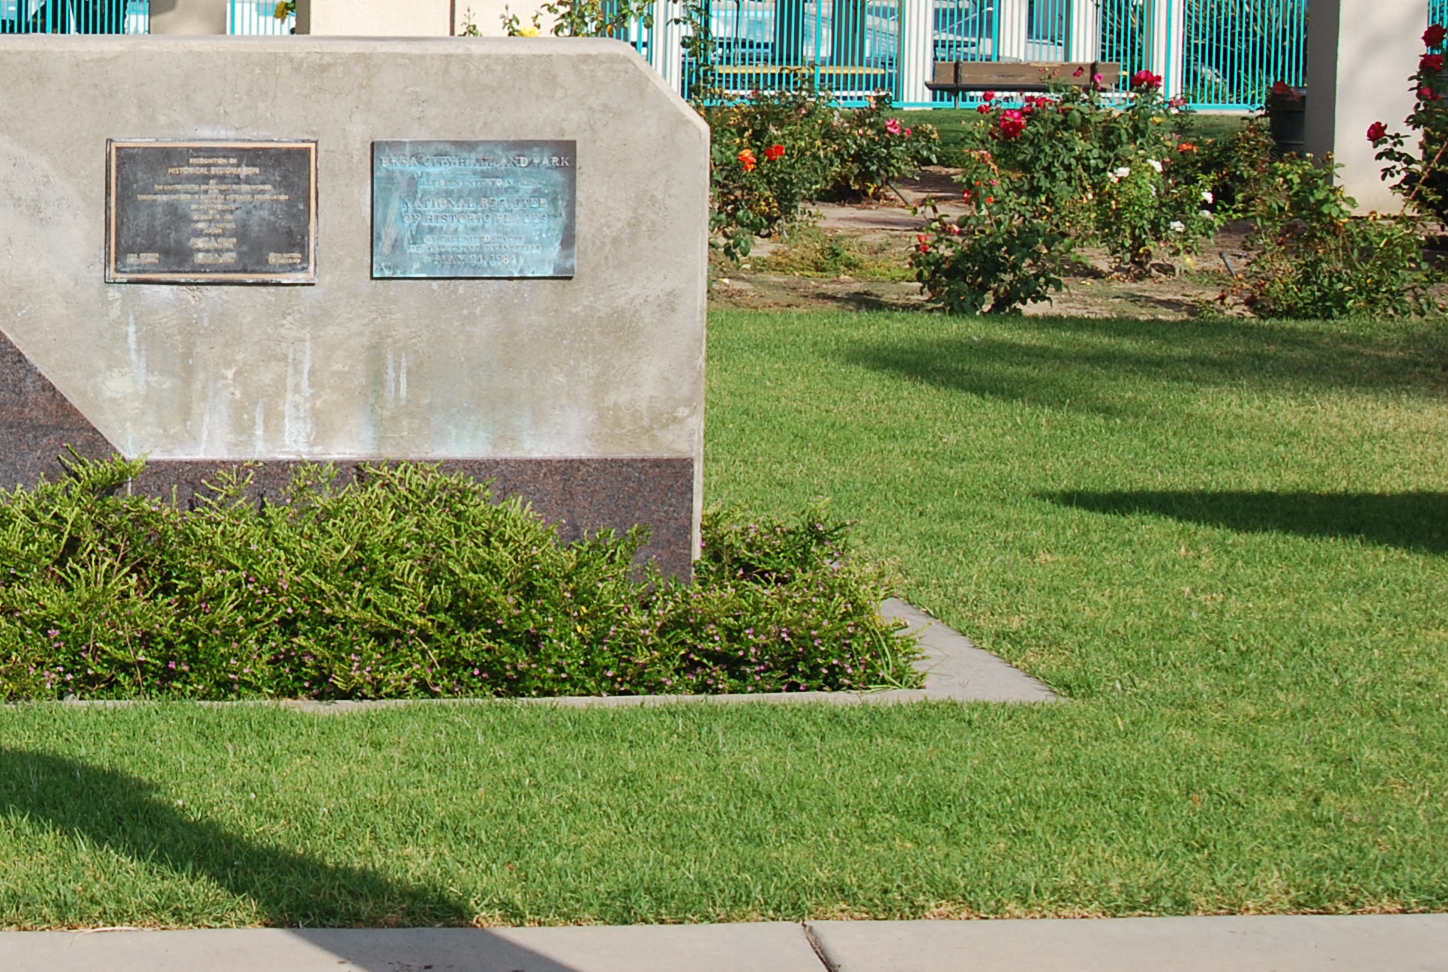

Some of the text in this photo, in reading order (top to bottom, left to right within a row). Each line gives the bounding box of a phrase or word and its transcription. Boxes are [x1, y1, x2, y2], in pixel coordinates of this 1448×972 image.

[498, 155, 529, 167] AND
[532, 155, 570, 167] PARK
[167, 166, 209, 175] HISTORICAL
[400, 197, 476, 209] NATIONAL
[423, 212, 492, 224] HISTORIC
